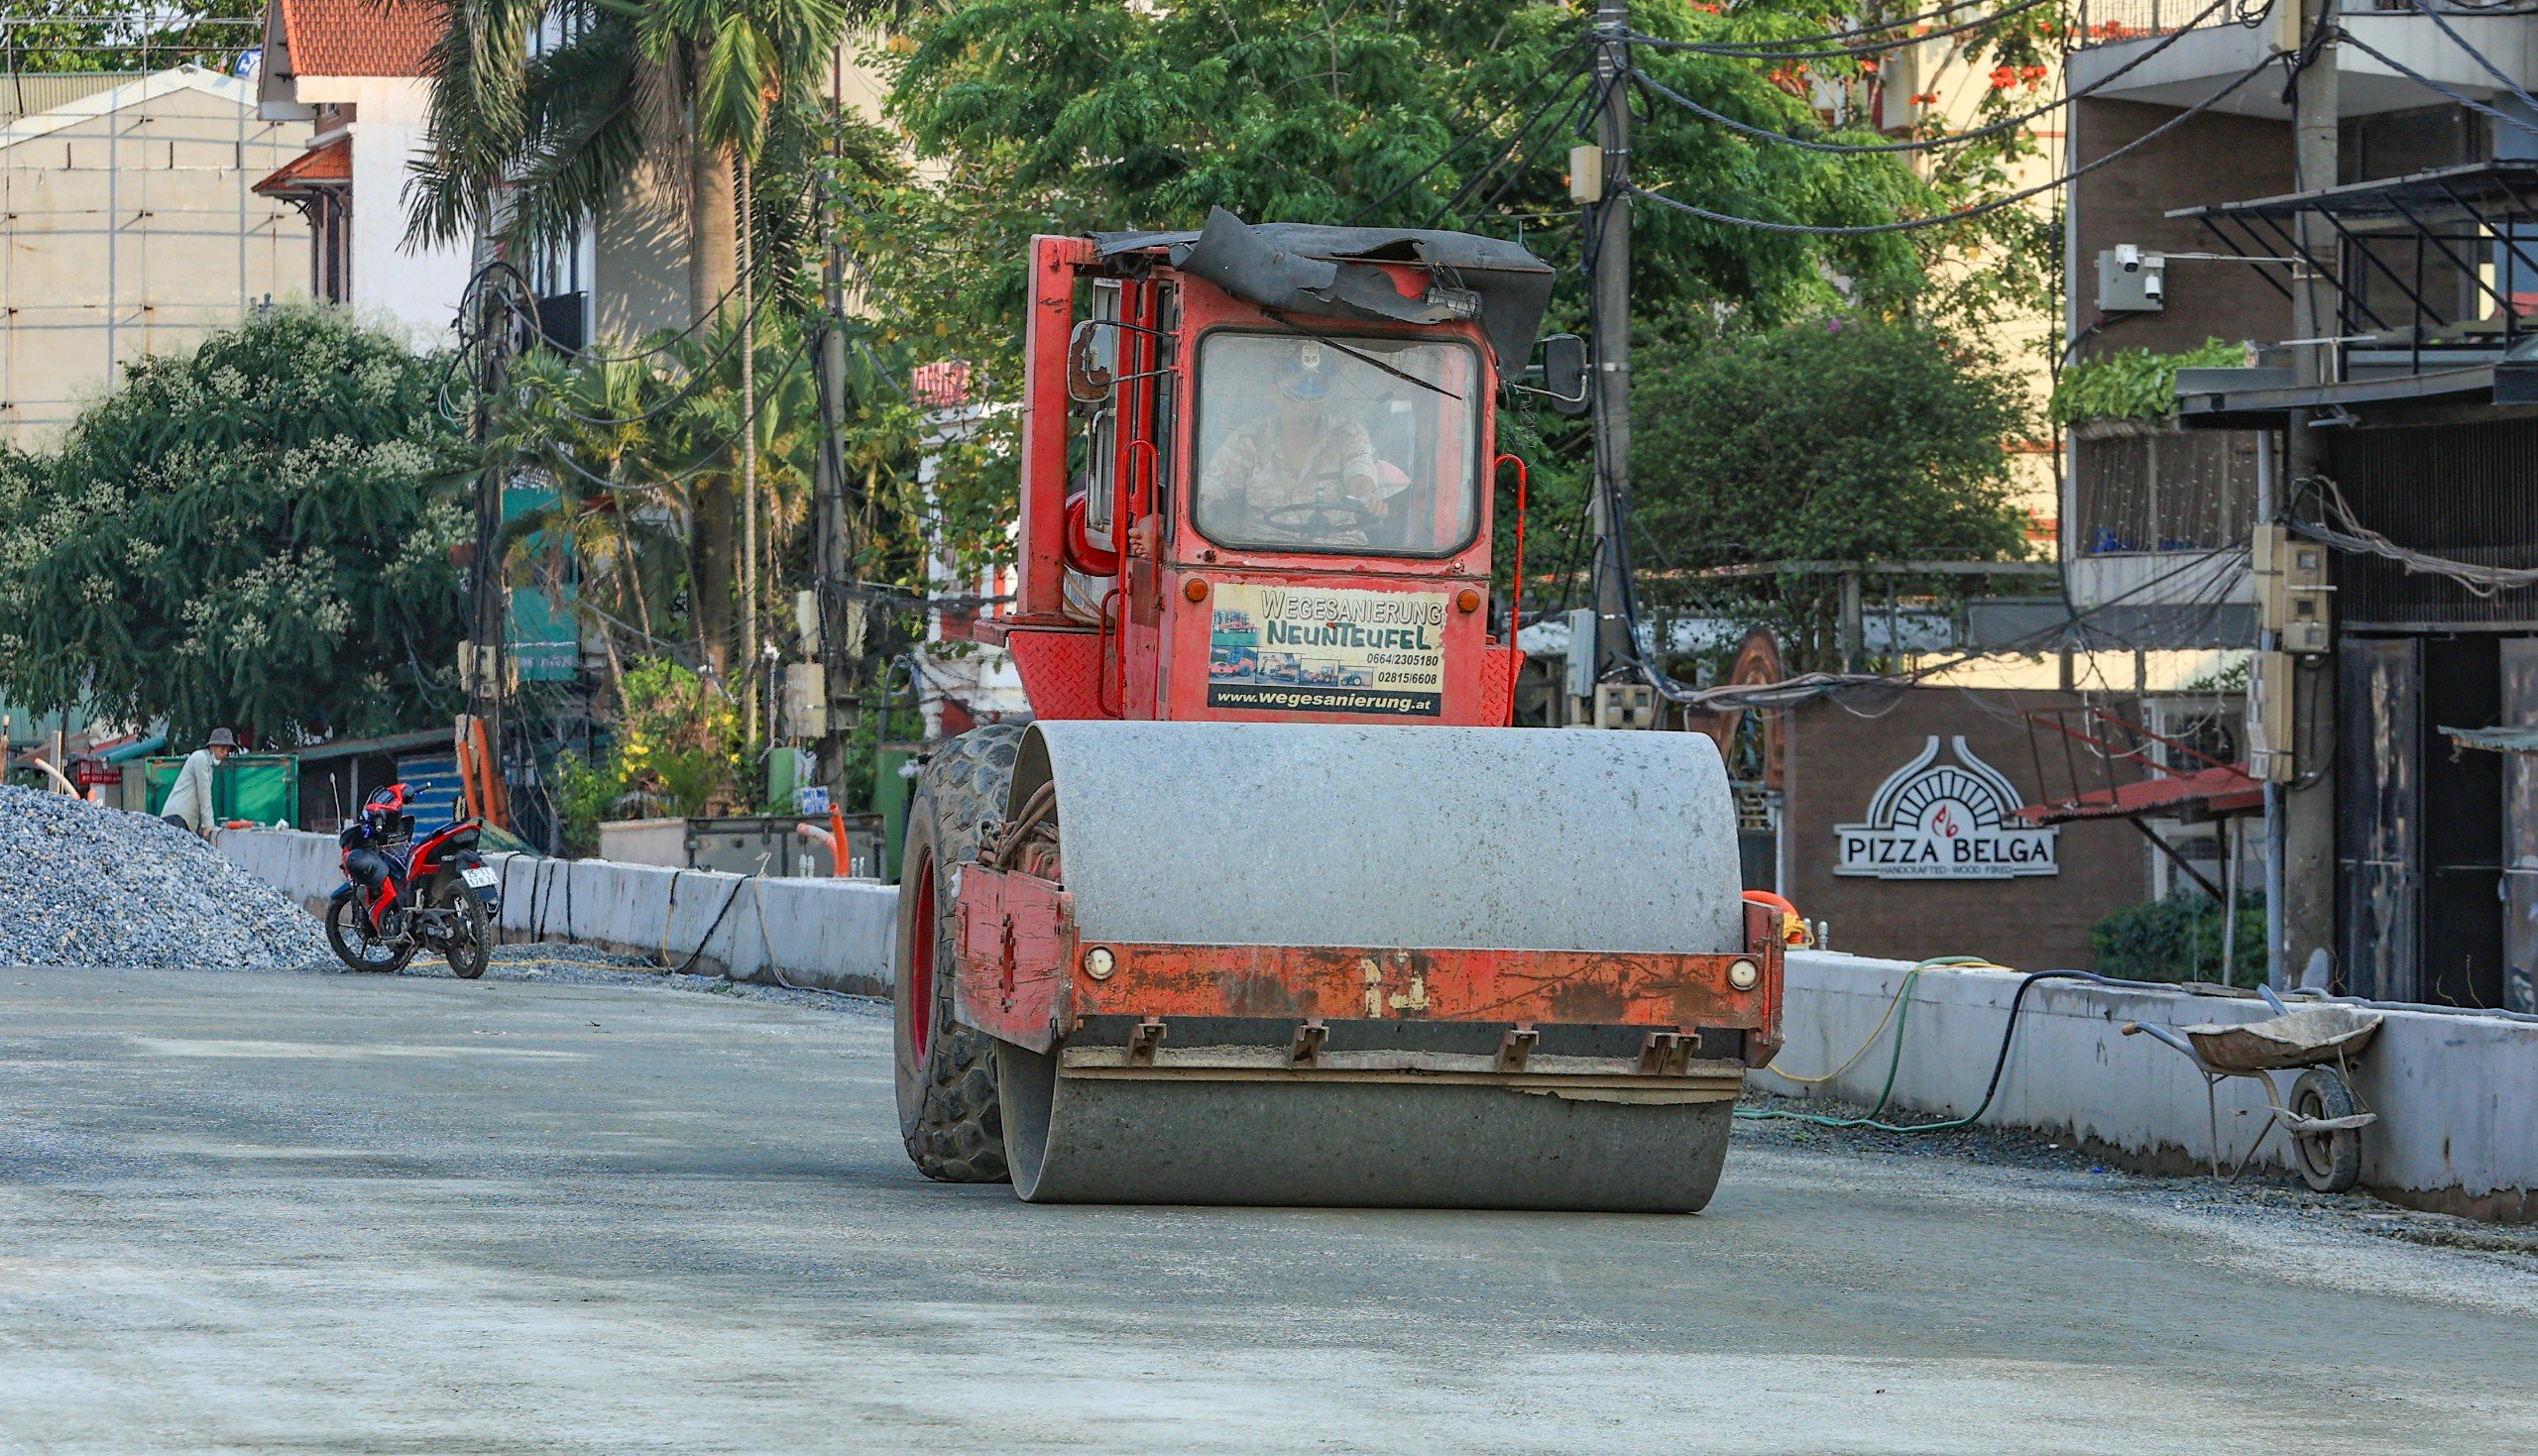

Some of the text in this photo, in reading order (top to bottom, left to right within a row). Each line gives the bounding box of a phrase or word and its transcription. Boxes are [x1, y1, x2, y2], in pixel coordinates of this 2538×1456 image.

[1260, 590, 1442, 625] WEGESANIERUNG
[1266, 619, 1432, 650] NEUNTEUFEL
[1366, 652, 1439, 667] 0664/2305180
[1378, 671, 1438, 685] 02815/6608
[1217, 692, 1432, 712] www.wegesanierung.at
[1847, 839, 2048, 863] PIZZA BELGA
